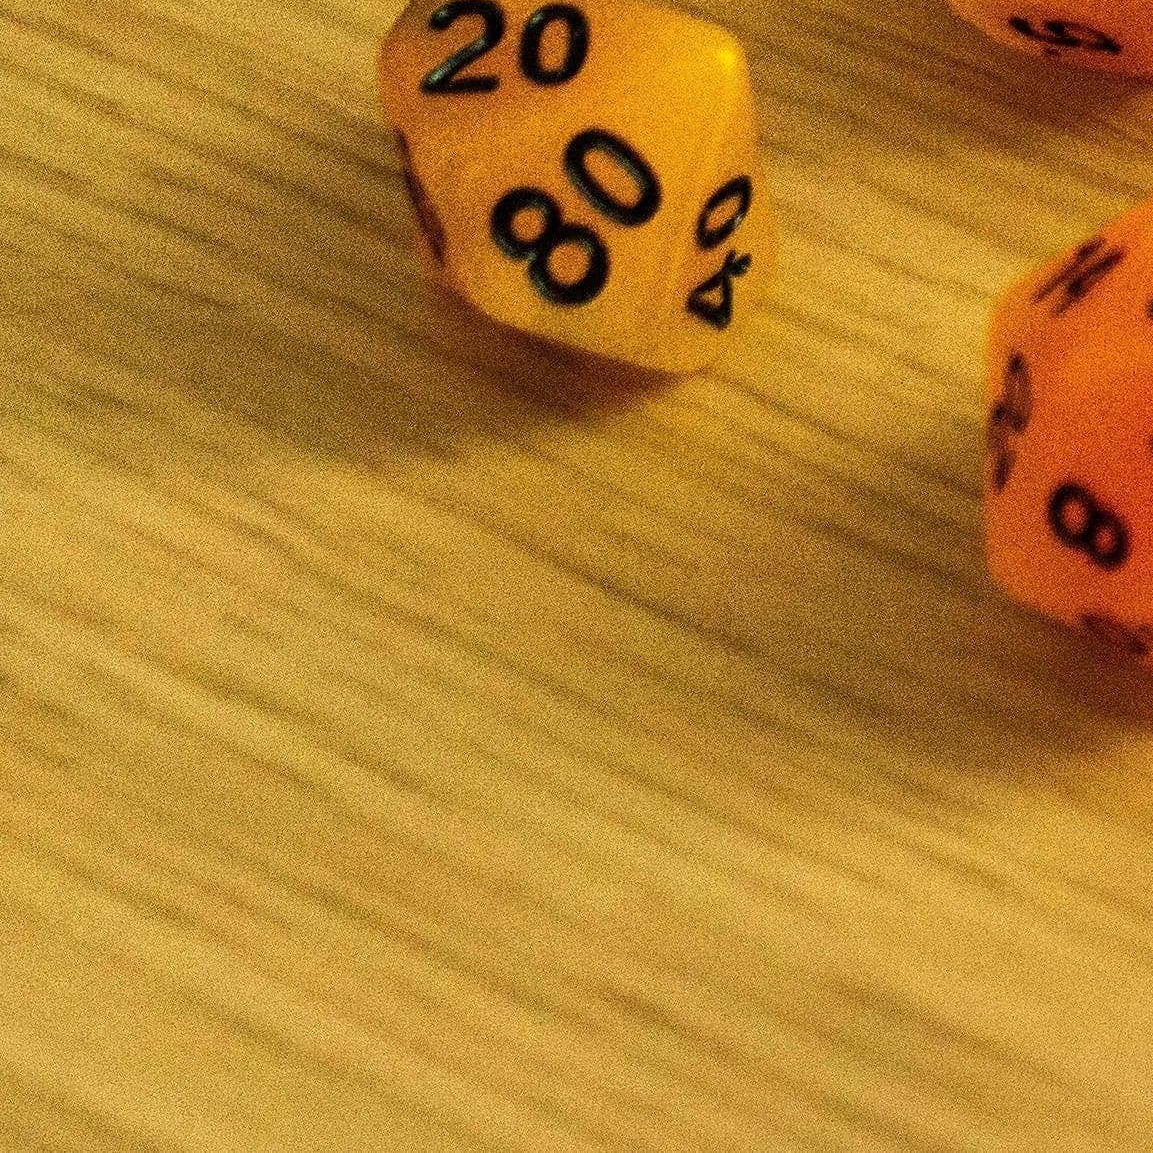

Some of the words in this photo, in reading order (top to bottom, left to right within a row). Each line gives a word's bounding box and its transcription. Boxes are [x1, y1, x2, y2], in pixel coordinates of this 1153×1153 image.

[489, 127, 662, 308] 80
[685, 174, 753, 331] 40
[1047, 480, 1130, 570] 8
